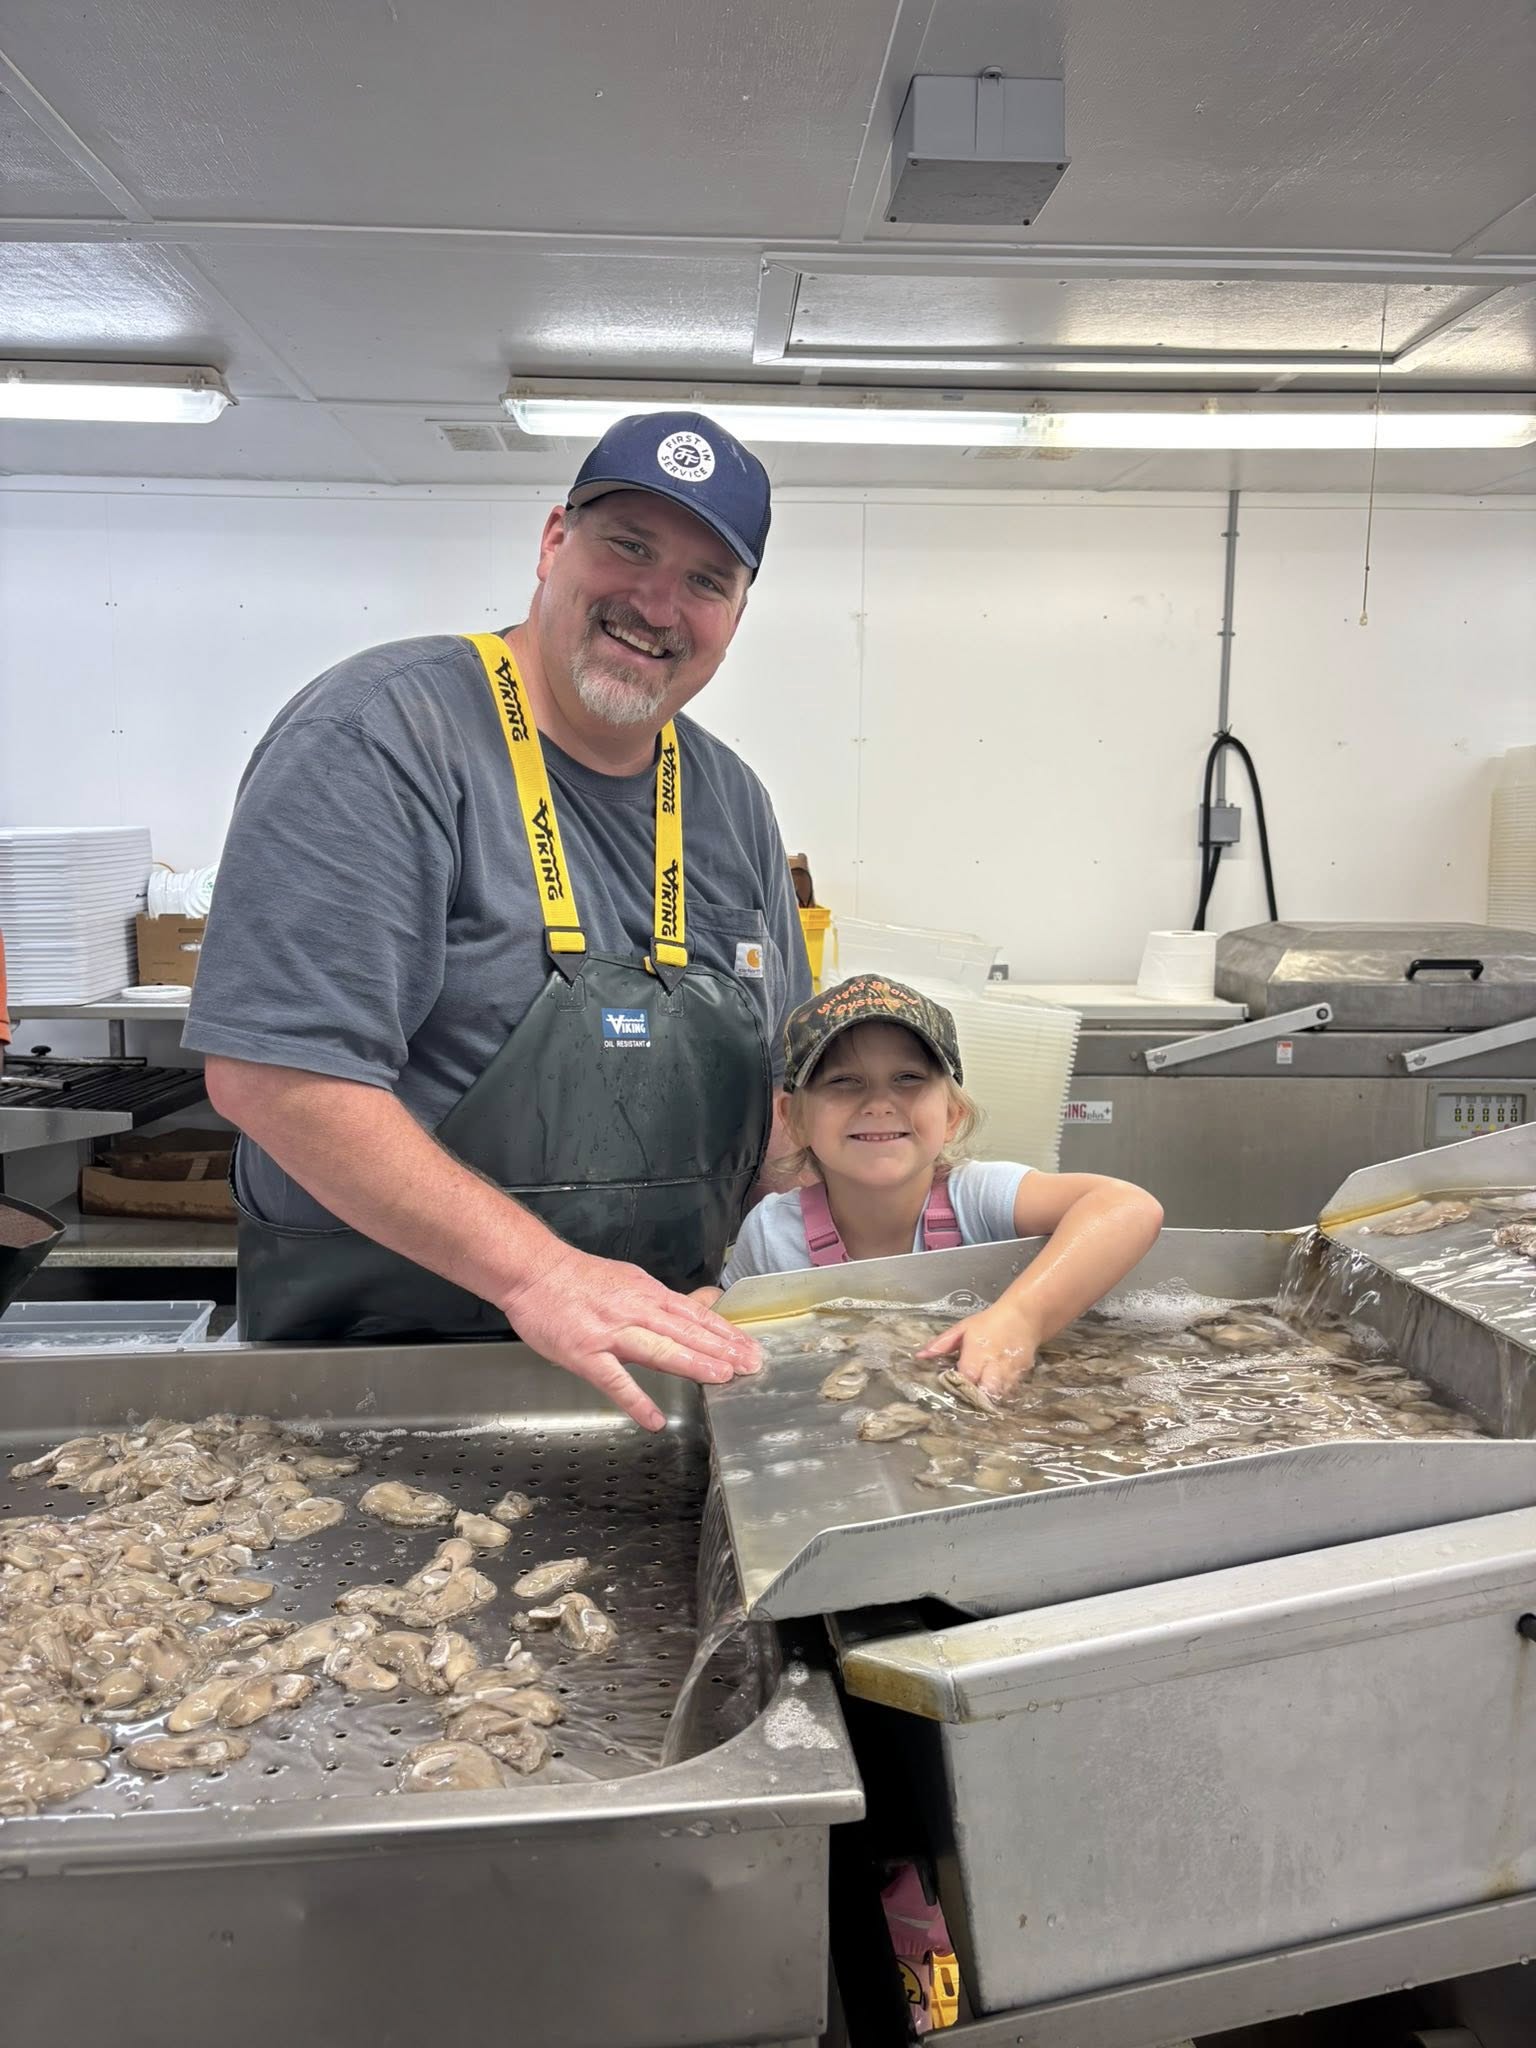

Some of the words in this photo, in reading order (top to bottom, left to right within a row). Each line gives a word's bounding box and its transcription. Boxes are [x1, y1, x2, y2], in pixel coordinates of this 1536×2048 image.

[666, 435, 701, 449] FIRST
[701, 449, 712, 461] IN
[661, 455, 708, 478] SERVICE
[494, 656, 529, 742] VIKING
[661, 742, 675, 816] VIKING
[531, 798, 564, 902] VIKING
[661, 859, 677, 938] VIKING
[834, 997, 901, 1017] Oysters
[605, 1013, 646, 1035] VIKING
[604, 1040, 615, 1048] OIL
[616, 1040, 646, 1048] RESISTANT
[1064, 1103, 1087, 1119] ING
